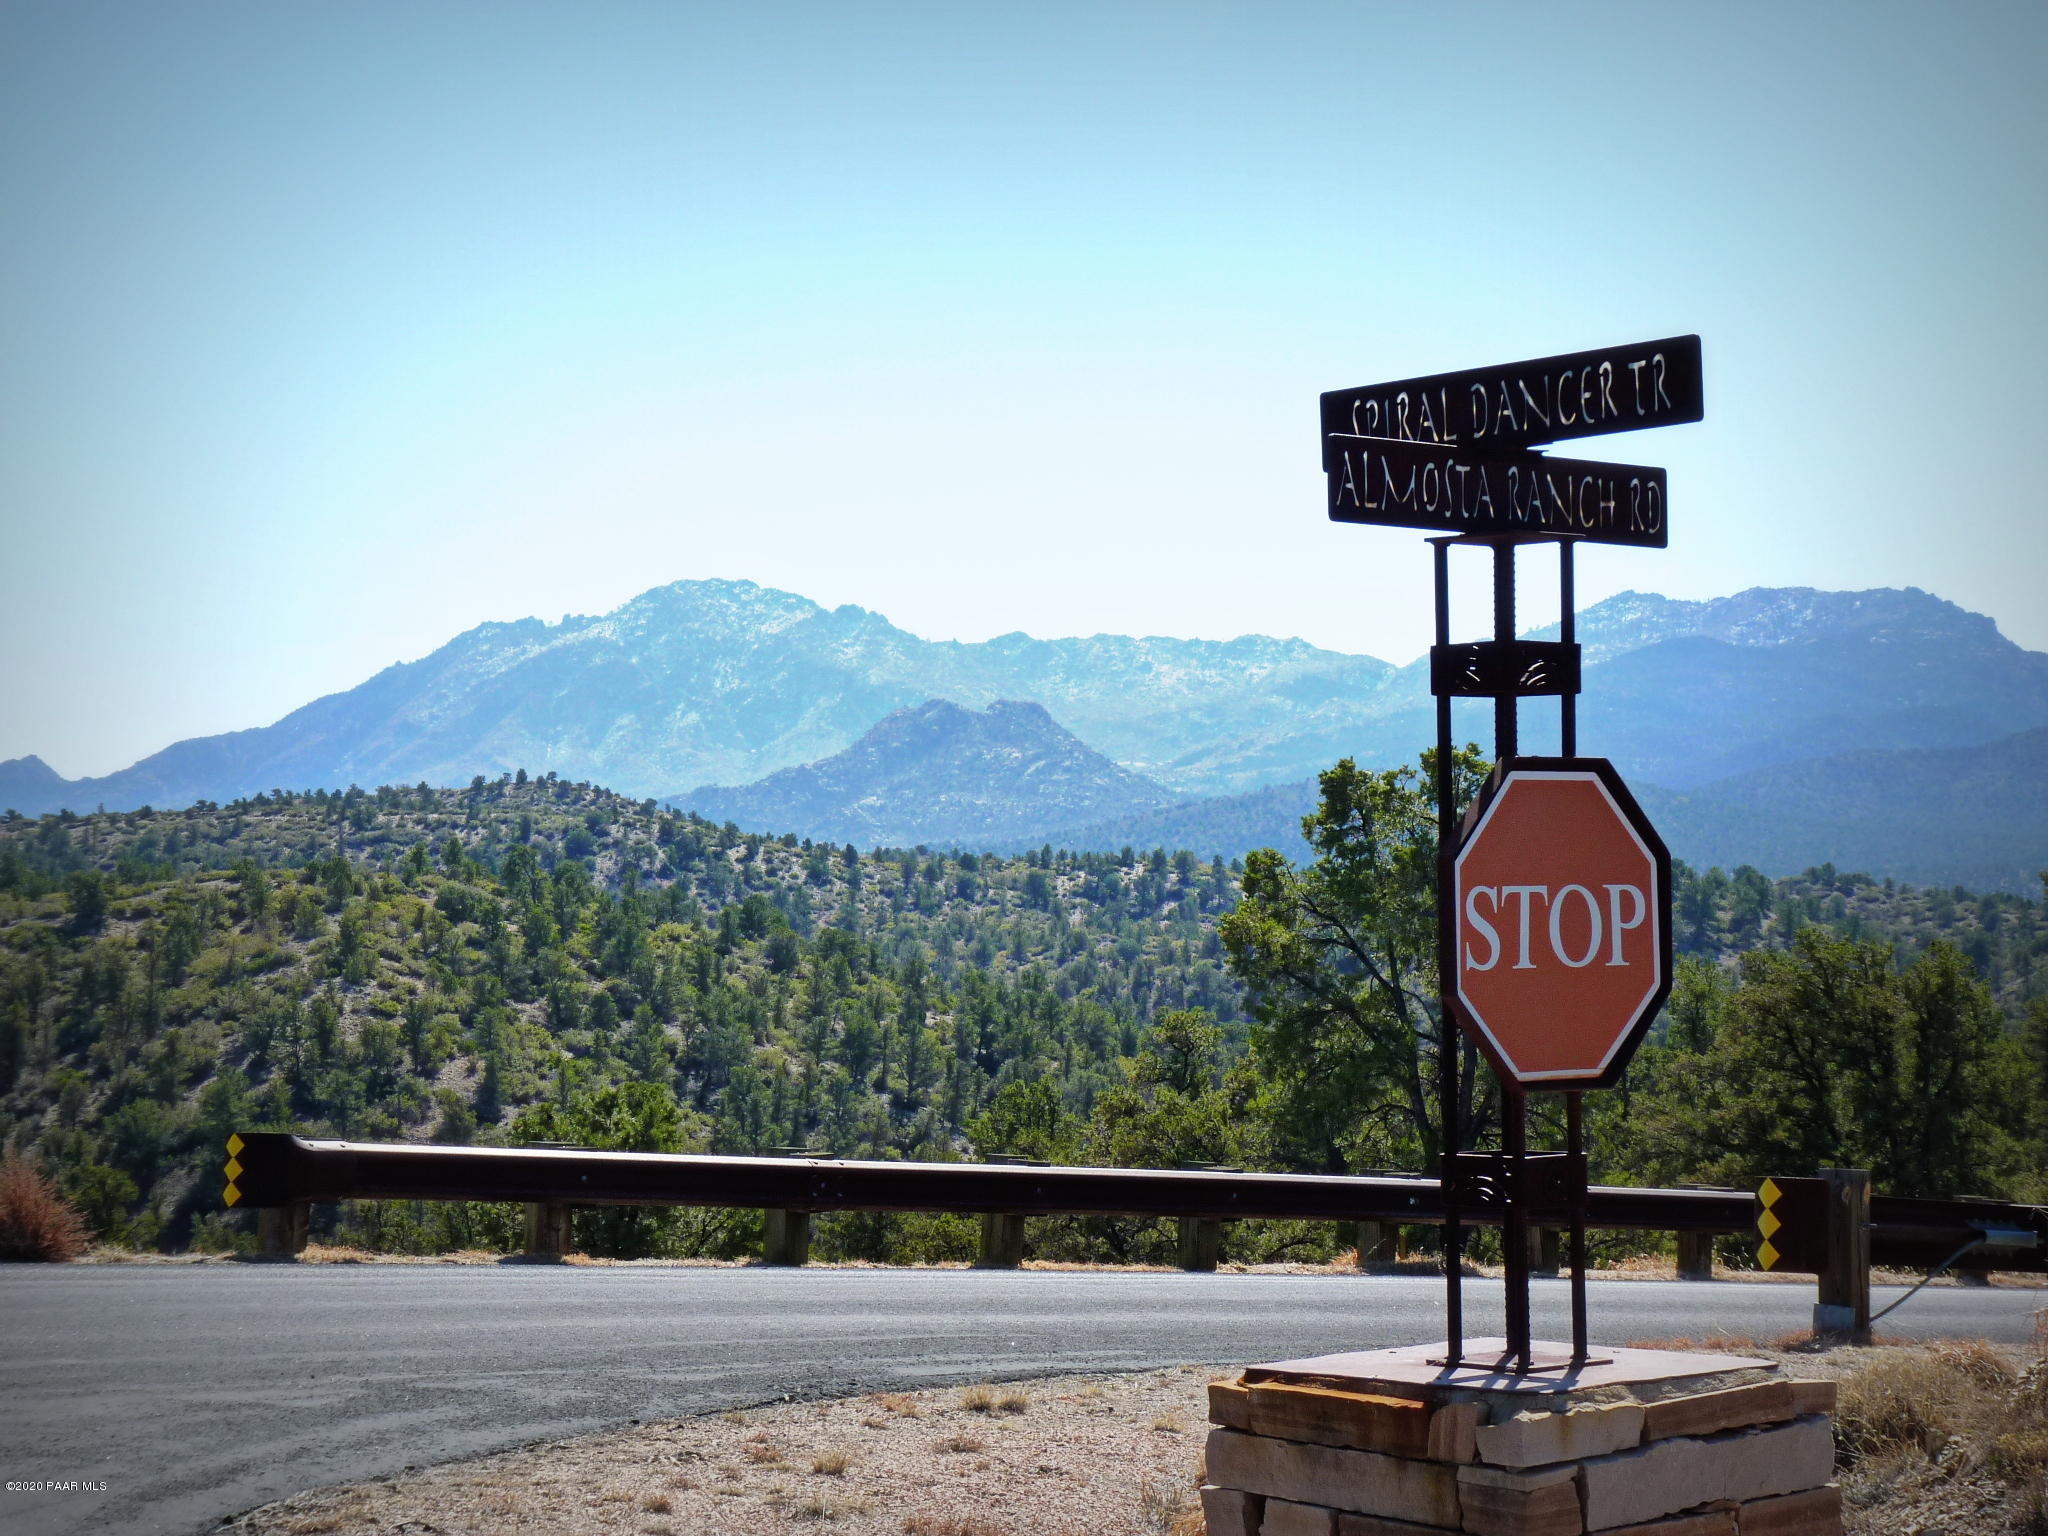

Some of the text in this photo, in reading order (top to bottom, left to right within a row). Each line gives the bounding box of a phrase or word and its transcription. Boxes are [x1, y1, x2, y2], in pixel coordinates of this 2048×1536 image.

[1352, 352, 1671, 442] SPIRAL DANCER TR
[1336, 449, 1662, 534] ALMOSTA RANCH RD
[1465, 884, 1646, 971] STOP
